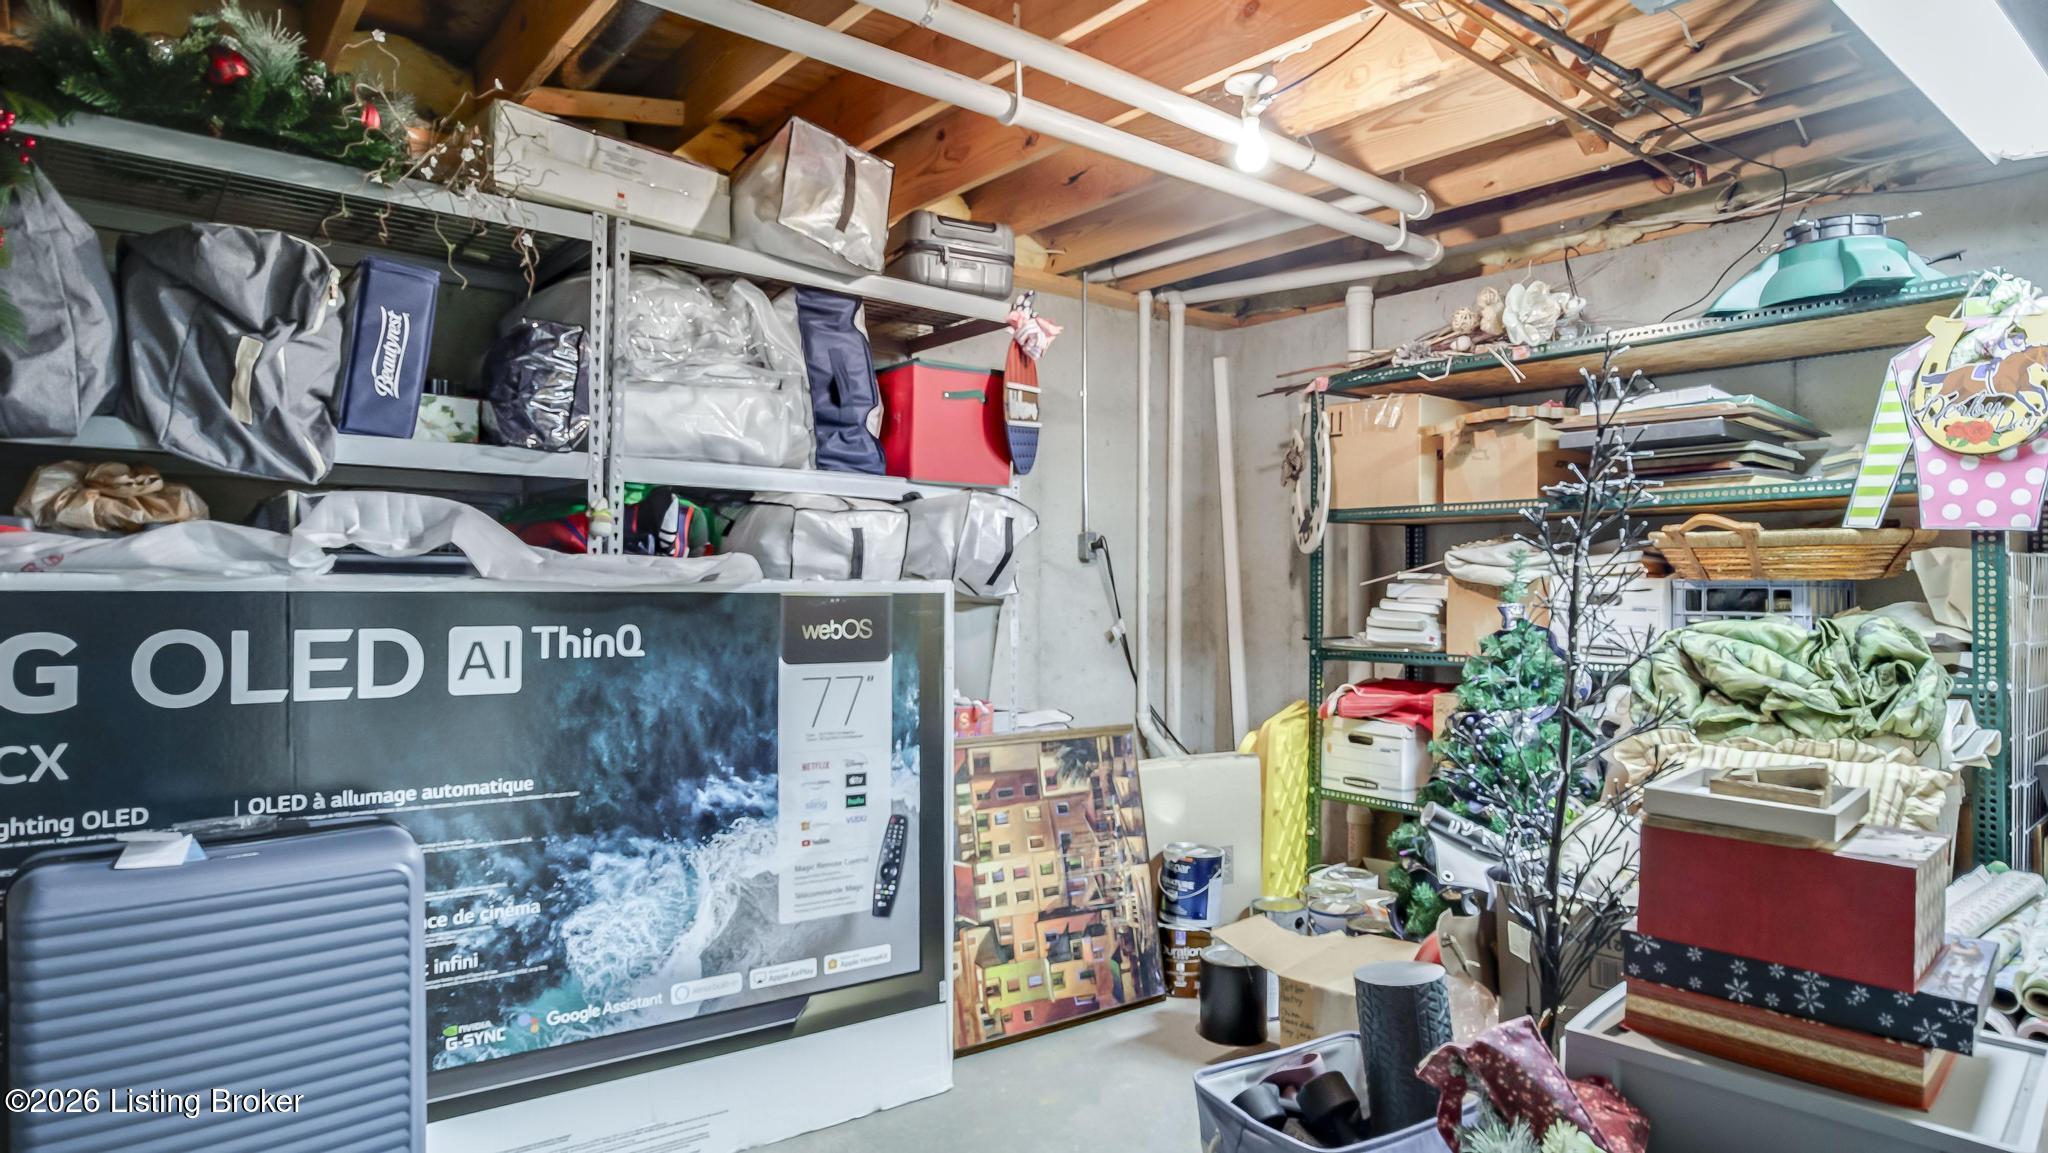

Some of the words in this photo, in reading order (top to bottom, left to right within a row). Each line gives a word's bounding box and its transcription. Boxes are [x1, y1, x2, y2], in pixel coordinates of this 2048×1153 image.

[801, 618, 873, 640] webOS
[131, 628, 425, 709] OLED
[458, 640, 511, 680] AI
[531, 623, 645, 660] ThinQ
[0, 742, 69, 785] CX
[247, 794, 308, 816] OLED
[312, 792, 326, 810] à
[330, 788, 417, 809] allumage
[421, 777, 534, 800] automatique
[82, 807, 149, 830] OLED
[452, 909, 475, 926] de
[480, 896, 541, 922] cinéma
[434, 952, 478, 975] infini
[546, 1003, 600, 1027] Google
[602, 993, 663, 1016] Assistant
[445, 1026, 507, 1051] G-SYNC
